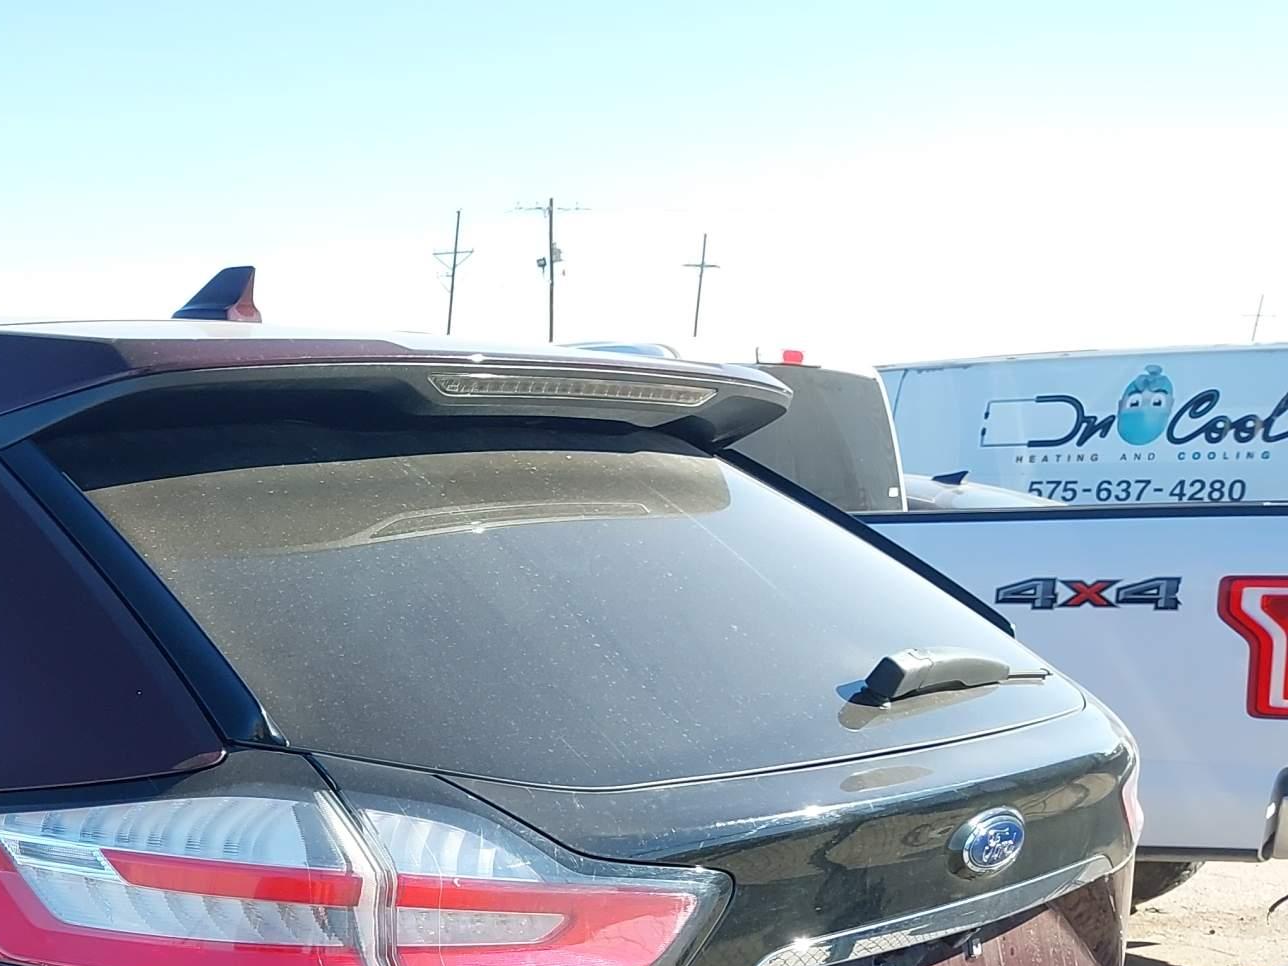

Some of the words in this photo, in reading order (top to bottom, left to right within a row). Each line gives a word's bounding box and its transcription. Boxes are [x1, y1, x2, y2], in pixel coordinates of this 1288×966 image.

[1166, 389, 1288, 446] Cool
[1015, 453, 1099, 464] HEATING
[1120, 451, 1156, 462] AND
[1177, 450, 1271, 462] COOLING
[1027, 479, 1247, 502] 575-637-4280
